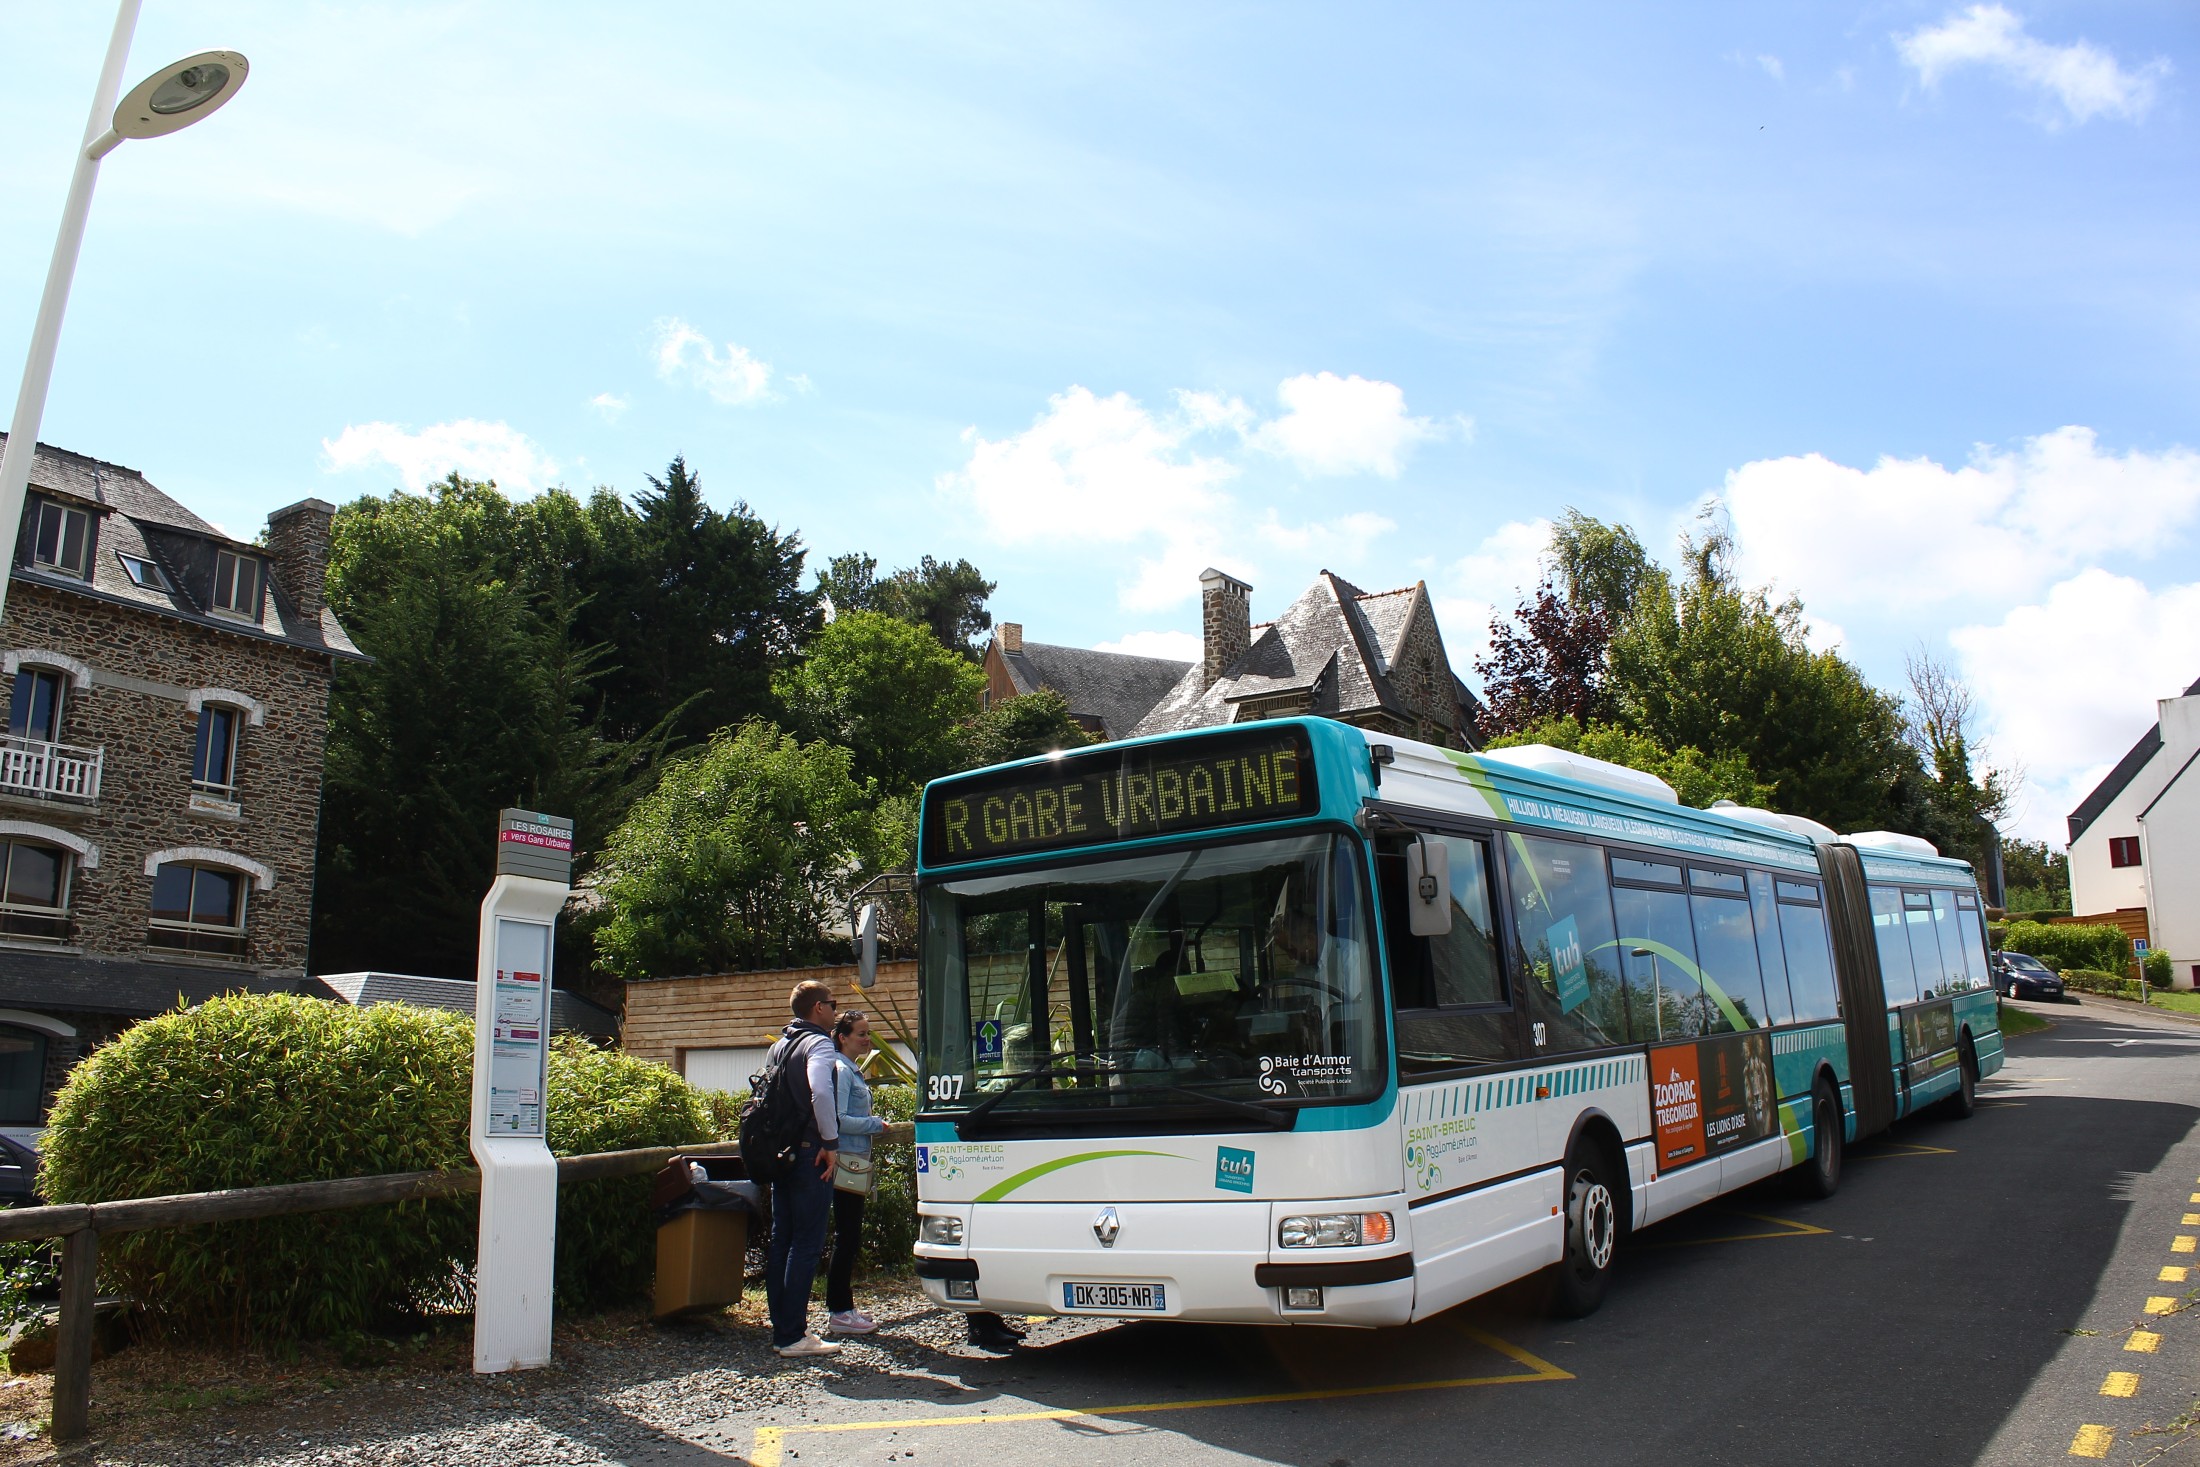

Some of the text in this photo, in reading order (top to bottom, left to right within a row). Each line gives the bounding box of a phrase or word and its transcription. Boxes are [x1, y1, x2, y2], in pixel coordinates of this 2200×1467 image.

[944, 750, 1298, 854] R GARE URBAINE
[1507, 797, 1540, 818] HILLION
[1540, 806, 1551, 820] LA
[1552, 804, 1589, 826] MÉAUGON
[1589, 813, 1624, 832] LANGUEUX
[502, 832, 571, 850] R vers Gare Urbaine
[511, 821, 573, 840] LES ROSAIRES
[1555, 931, 1580, 976] tub
[1532, 1022, 1546, 1047] 307
[1275, 1054, 1351, 1068] Baie d'Armor
[1290, 1066, 1352, 1077] Transports
[928, 1075, 964, 1101] 307
[1654, 1079, 1696, 1107] ZOOPARC
[1656, 1102, 1698, 1127] TREGOMEUR
[1706, 1113, 1746, 1138] LES LIONS D'ASIE
[1409, 1117, 1476, 1142] SAINT-BRIEUC
[933, 1145, 1004, 1154] SAINT-BRIEUC
[1426, 1136, 1477, 1159] Agglomération
[949, 1155, 1005, 1164] Agglomération
[1220, 1156, 1251, 1175] tub
[1076, 1285, 1152, 1307] DK-305-NR
[1155, 1298, 1164, 1308] 22
